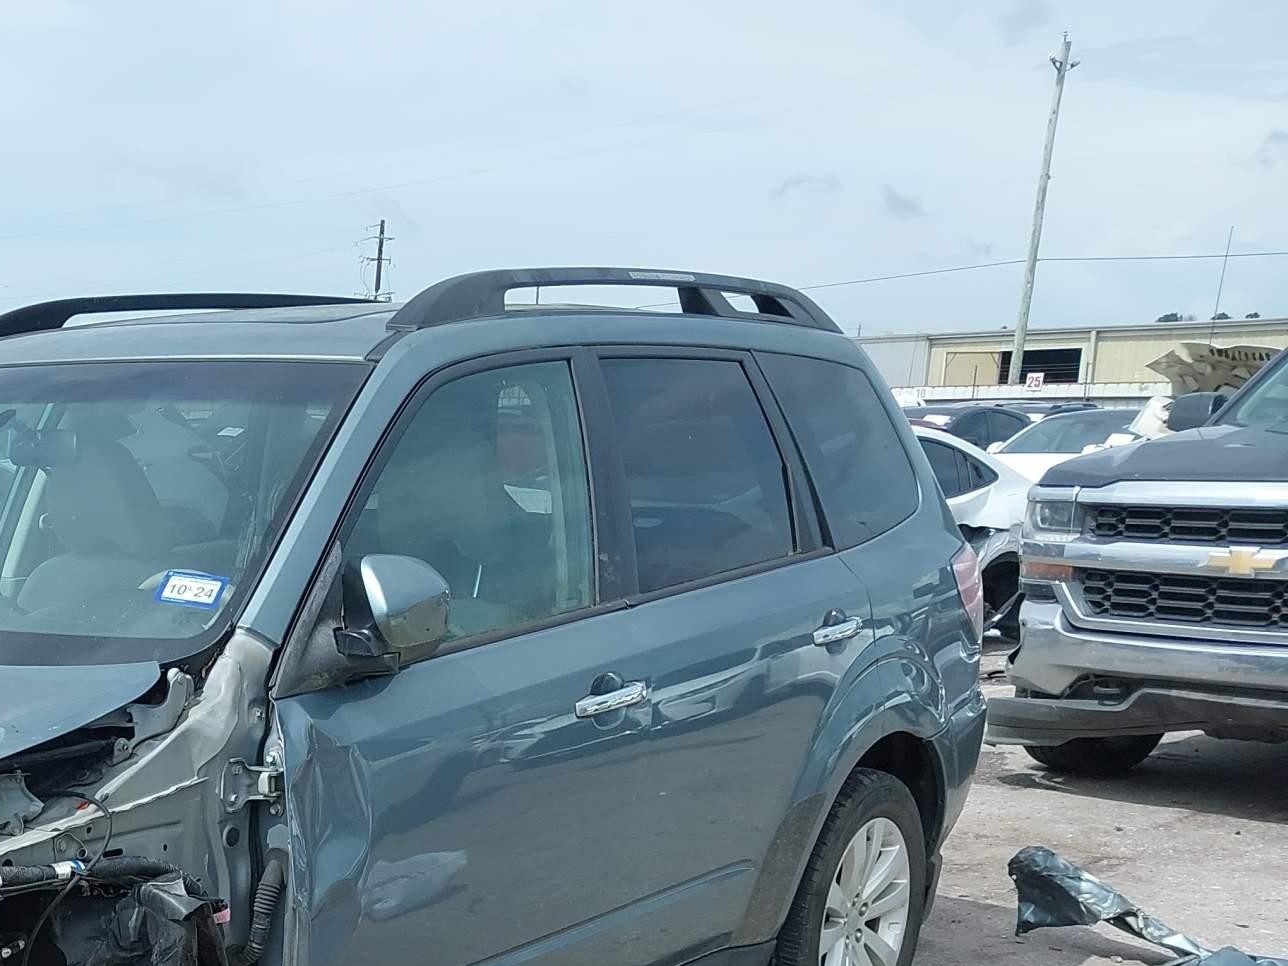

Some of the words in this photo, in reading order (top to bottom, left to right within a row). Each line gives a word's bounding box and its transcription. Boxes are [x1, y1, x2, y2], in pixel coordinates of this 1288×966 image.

[1027, 376, 1041, 388] 25
[169, 583, 187, 595] 10
[193, 586, 214, 599] 24
